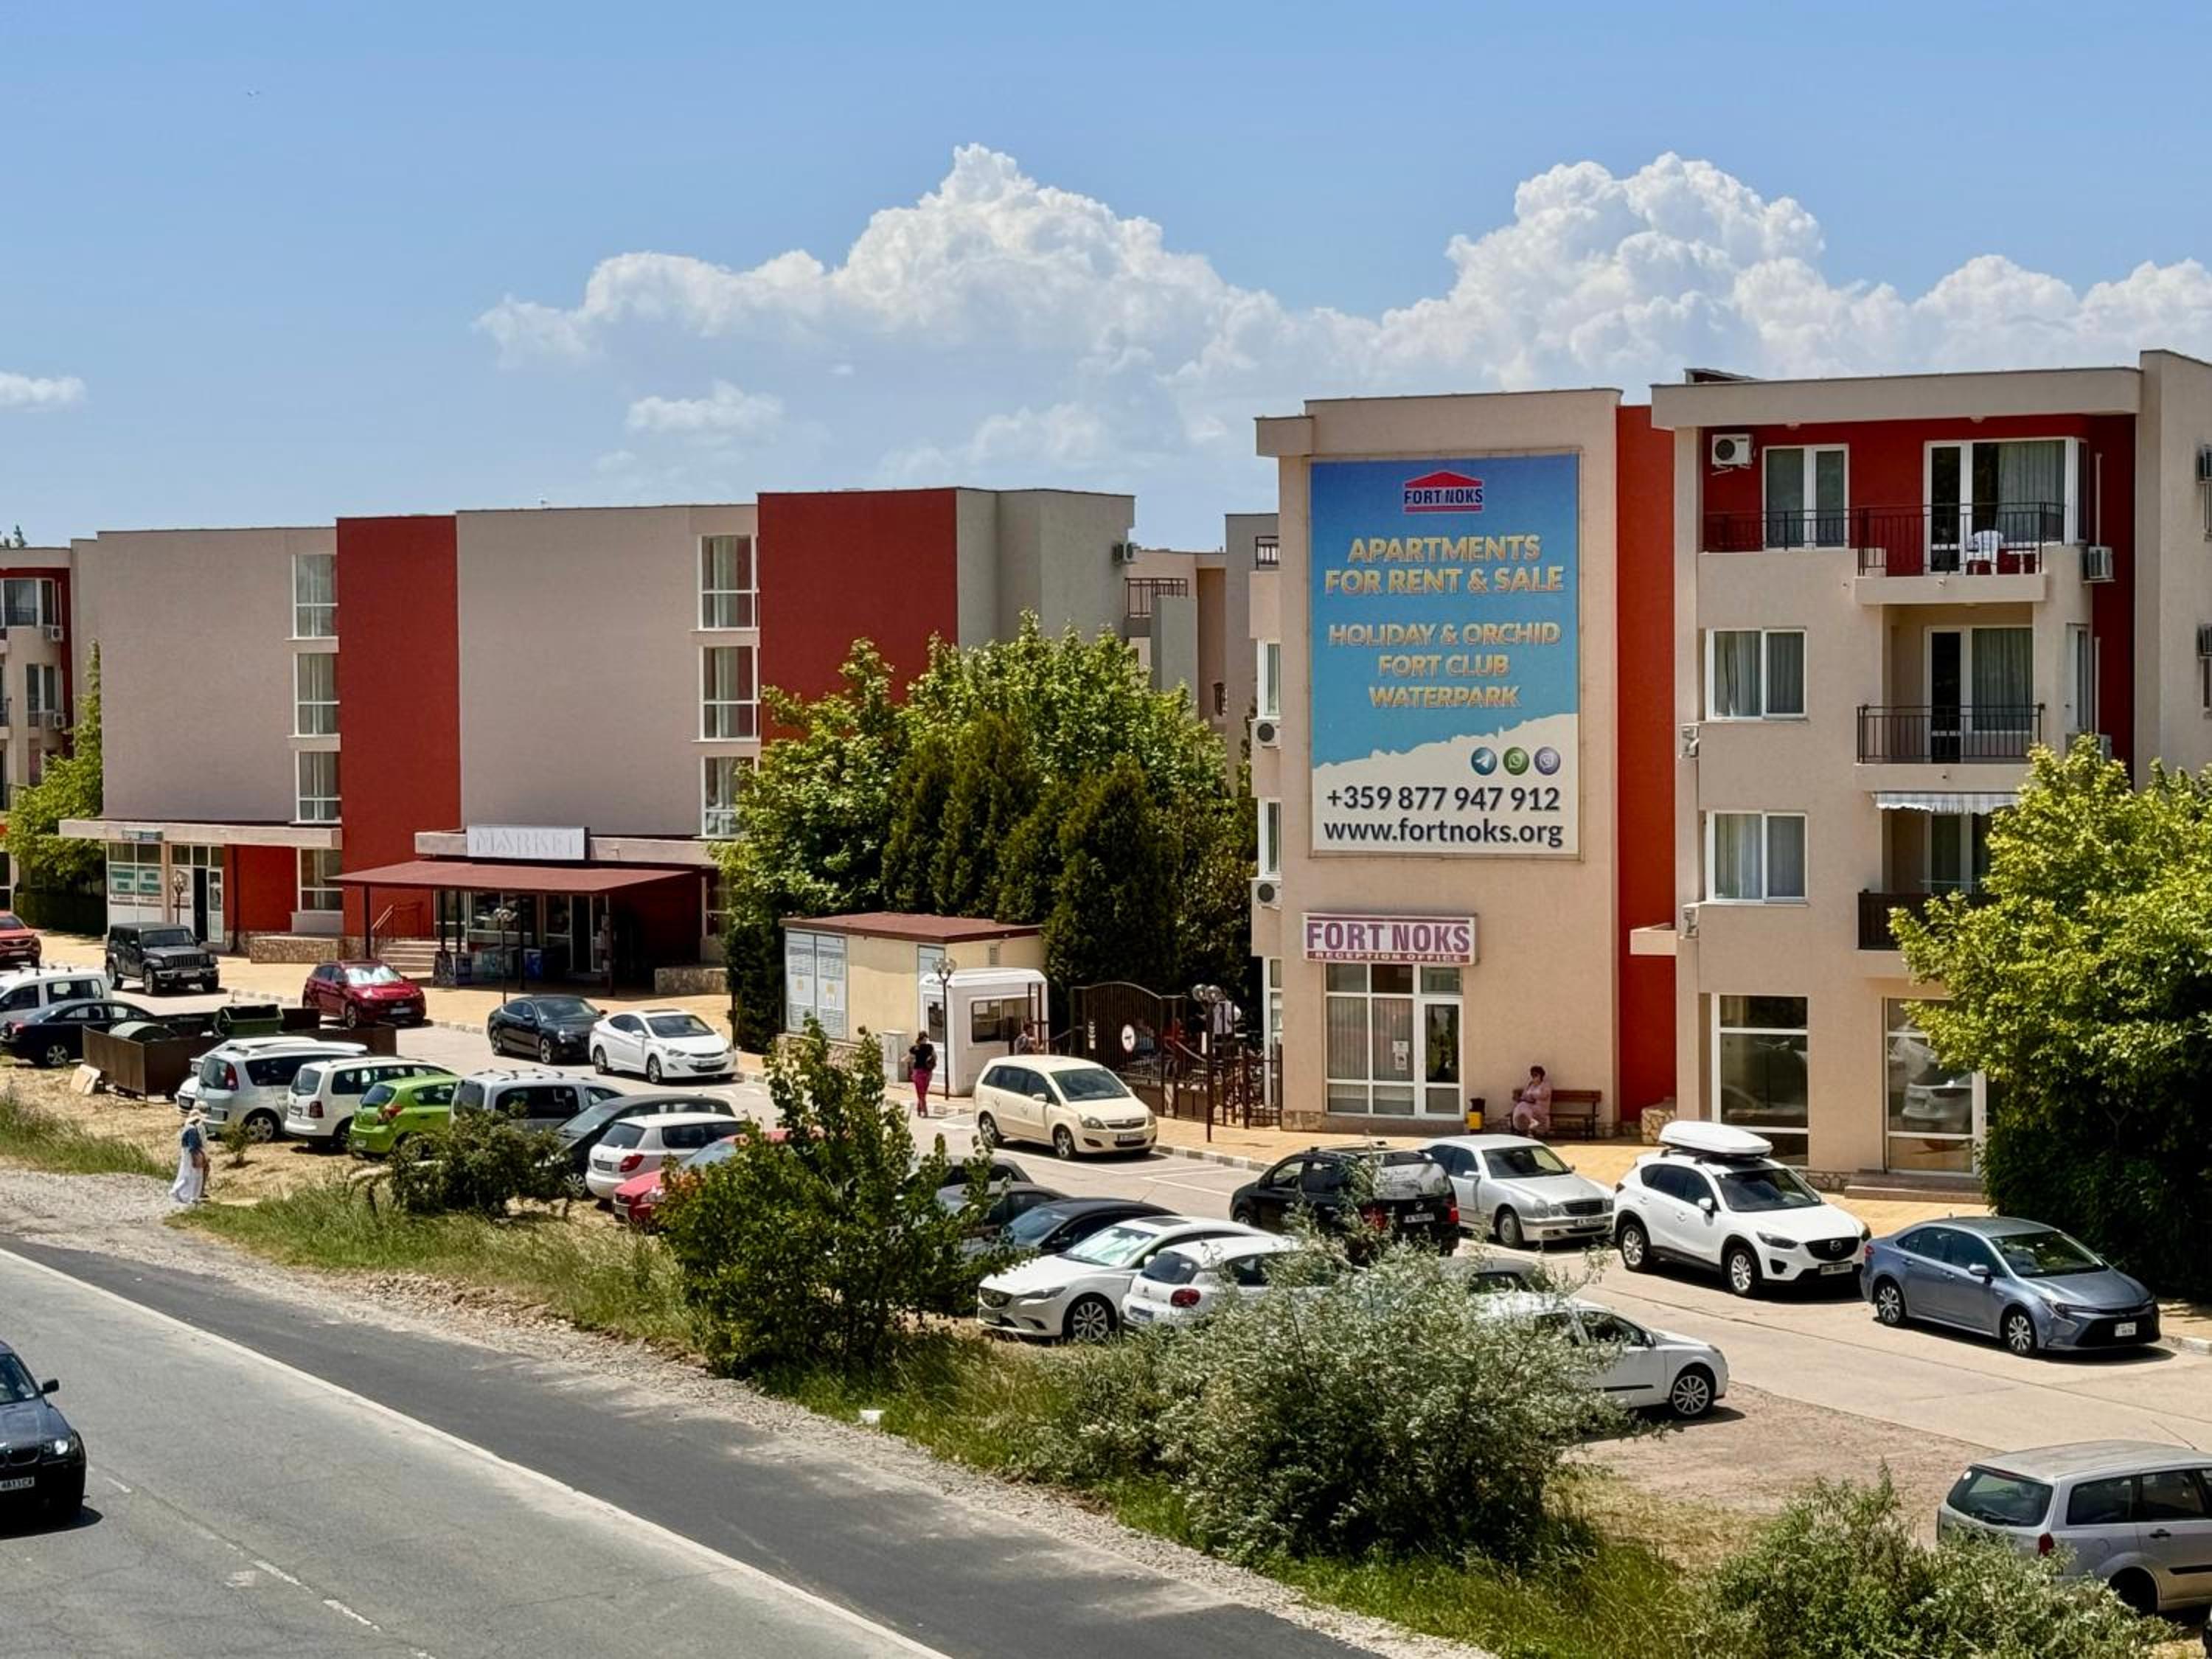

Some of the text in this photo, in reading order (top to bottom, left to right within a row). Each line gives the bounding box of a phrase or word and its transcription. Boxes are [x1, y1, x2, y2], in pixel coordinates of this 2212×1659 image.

[1404, 488, 1484, 504] FORT NOKS
[1348, 535, 1541, 563] APARTMENTS
[1325, 566, 1564, 594] FOR RENT & SALE
[1328, 622, 1561, 647] HOLIDAY & ORCHID
[1378, 654, 1510, 678] FORT CLUB
[1368, 686, 1520, 709] WATERPARK
[1327, 785, 1560, 811] +359 877 947 912
[1324, 818, 1563, 847] www.fortnoks.org
[1307, 922, 1470, 953] FORT NOKS
[1315, 951, 1461, 963] RECEPTION OFFICE
